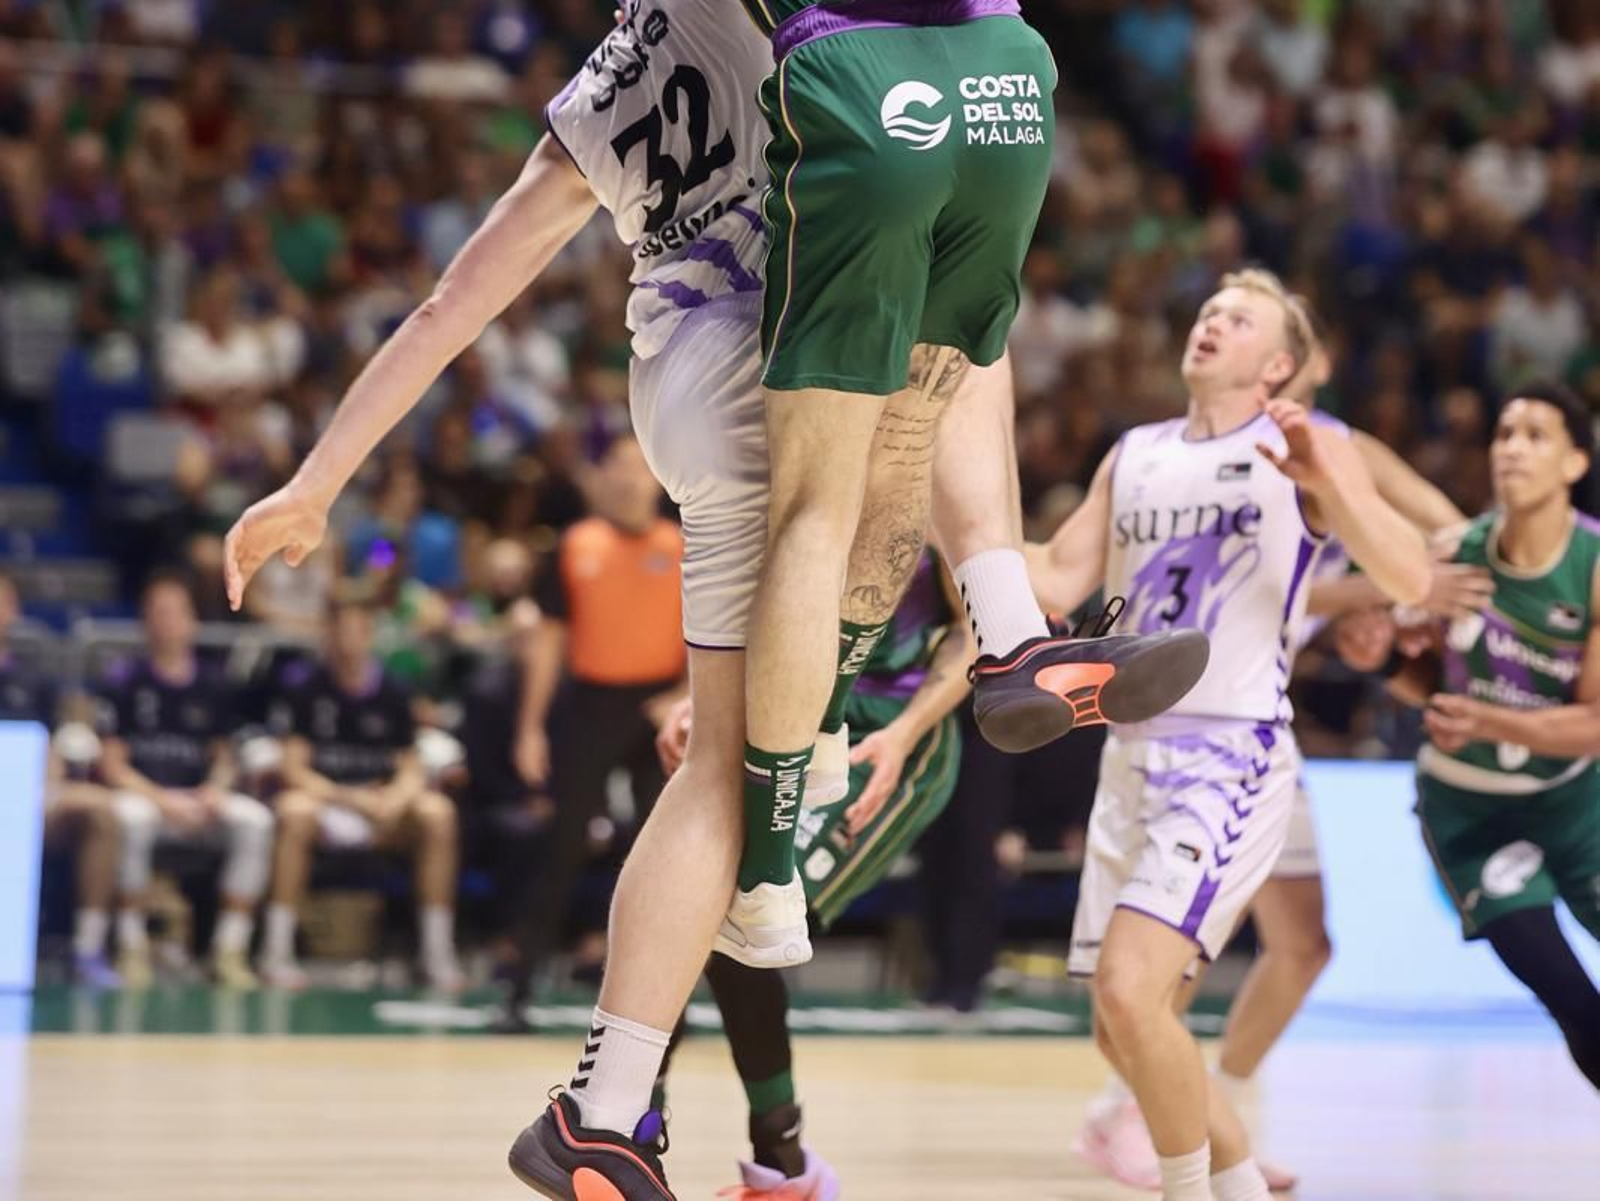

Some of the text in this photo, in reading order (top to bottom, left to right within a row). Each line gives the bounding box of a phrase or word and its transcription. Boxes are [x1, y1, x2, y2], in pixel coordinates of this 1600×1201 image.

[959, 74, 1042, 100] COSTA
[963, 101, 1044, 123] DEL SOL
[966, 123, 1045, 145] MÁLAGA
[610, 64, 736, 234] 32
[1115, 500, 1263, 548] surne
[1160, 566, 1193, 623] 3
[770, 768, 802, 832] UNICAJA
